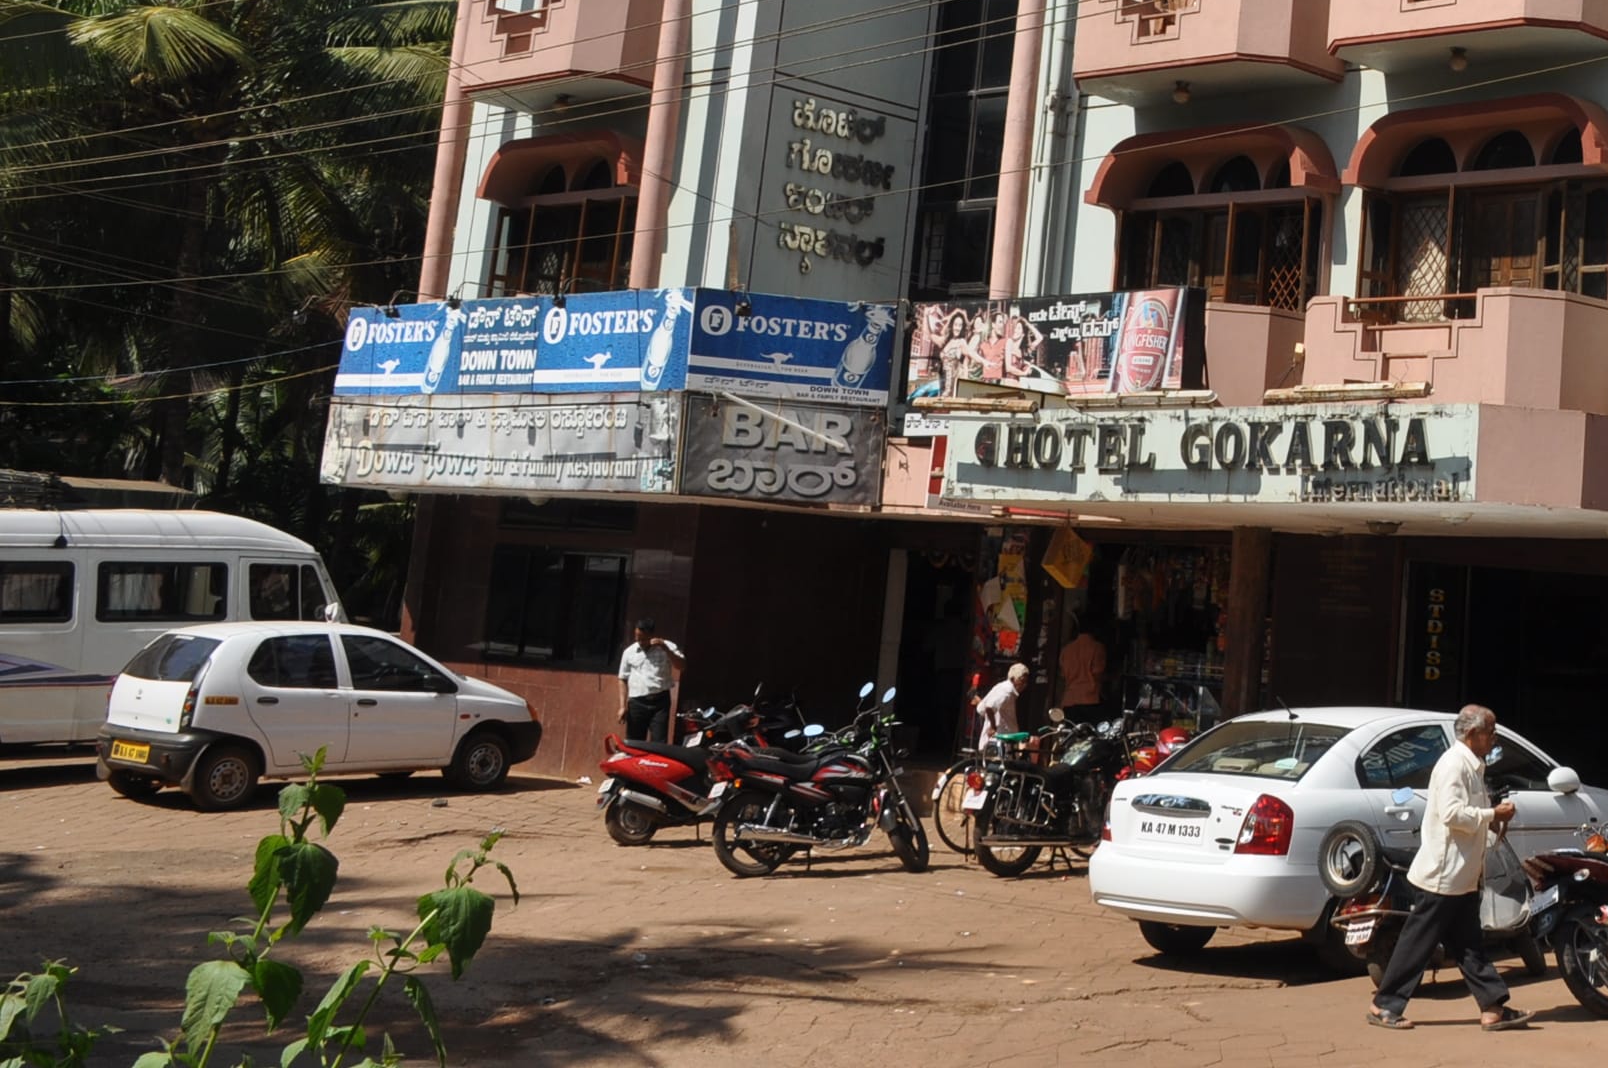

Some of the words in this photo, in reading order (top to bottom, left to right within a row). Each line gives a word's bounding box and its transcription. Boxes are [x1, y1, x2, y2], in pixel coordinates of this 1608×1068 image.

[366, 320, 437, 344] FOSTER'S
[568, 308, 655, 336] FOSTER'S
[736, 314, 848, 342] FOSTER'S
[460, 350, 498, 371] DOWN
[500, 349, 537, 371] TOWN
[810, 385, 839, 394] DOWN
[842, 387, 870, 397] TOWN
[722, 404, 853, 453] BAR
[1002, 422, 1156, 473] HOTEL
[1180, 417, 1436, 474] GOKARNA
[707, 458, 857, 496] ಬಾರ್
[1141, 821, 1153, 833] KA
[1155, 823, 1166, 834] 47
[1167, 824, 1176, 835] M
[1178, 824, 1201, 837] 1333
